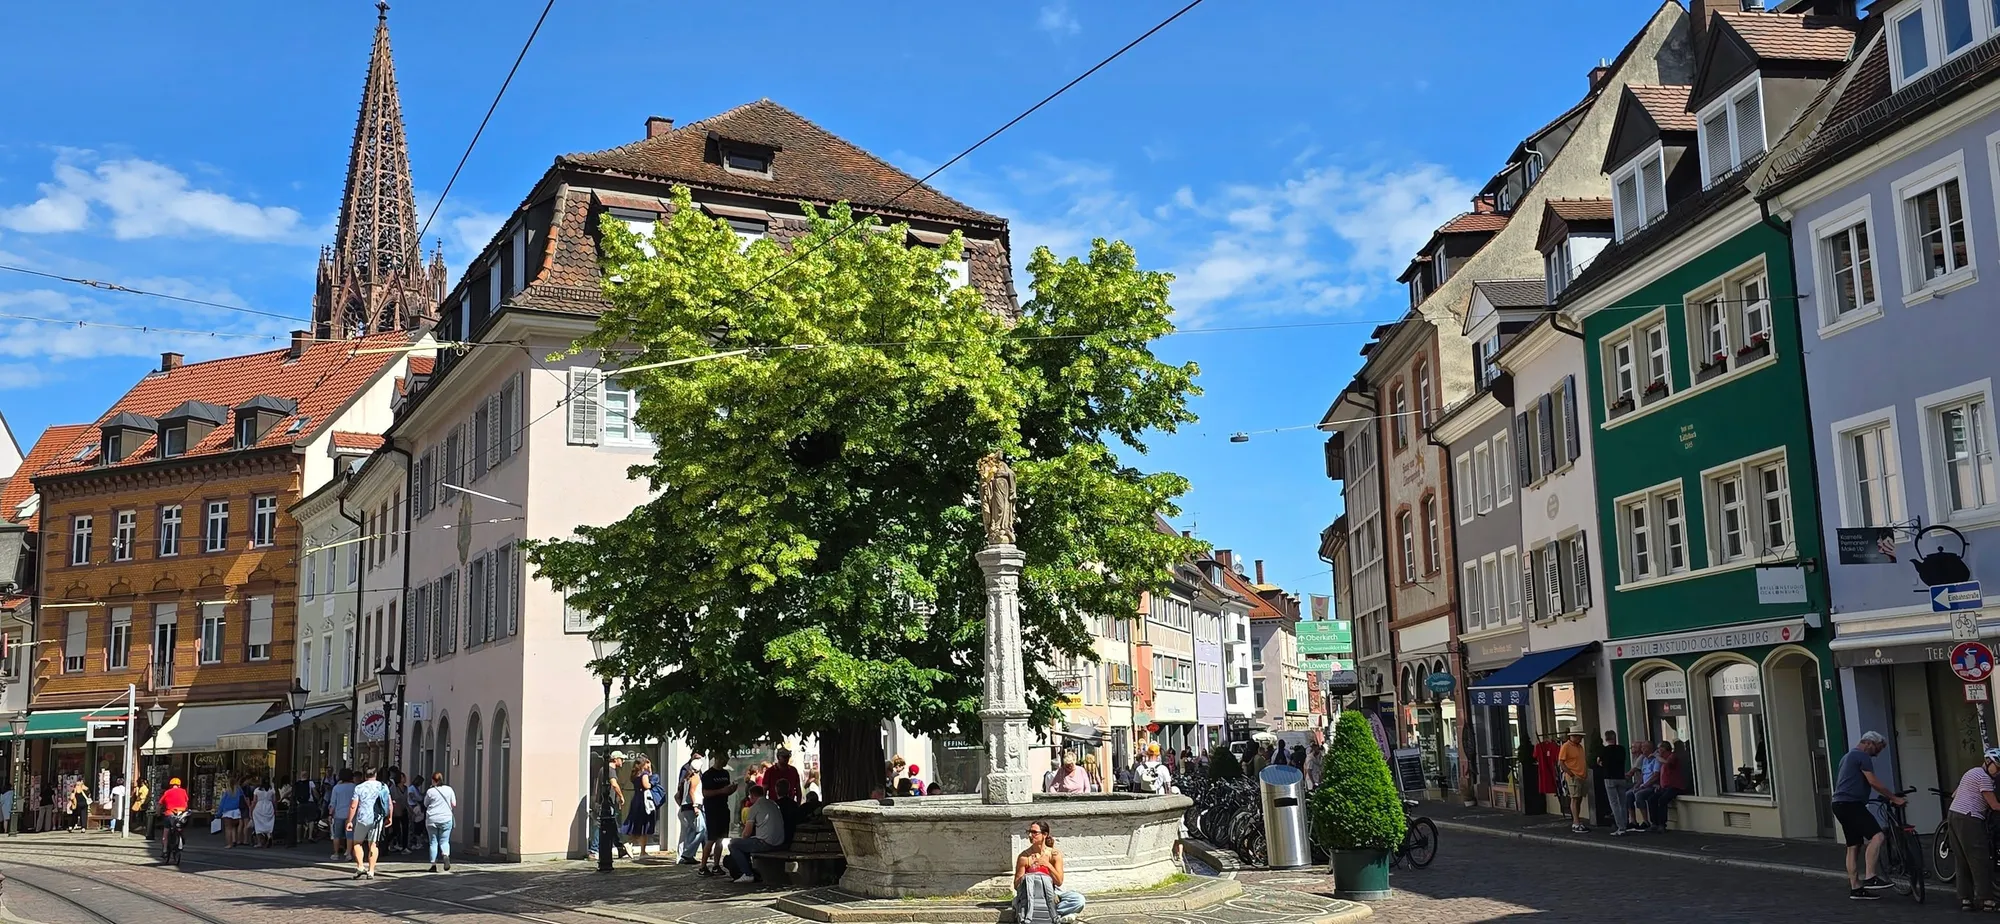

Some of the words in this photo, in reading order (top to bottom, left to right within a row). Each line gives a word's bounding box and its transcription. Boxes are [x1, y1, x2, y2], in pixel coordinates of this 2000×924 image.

[1948, 592, 1979, 601] Einbahnstraße
[1305, 633, 1338, 641] Oberkirch
[1700, 630, 1769, 649] OCKLENBURG
[1925, 647, 1944, 660] TEE
